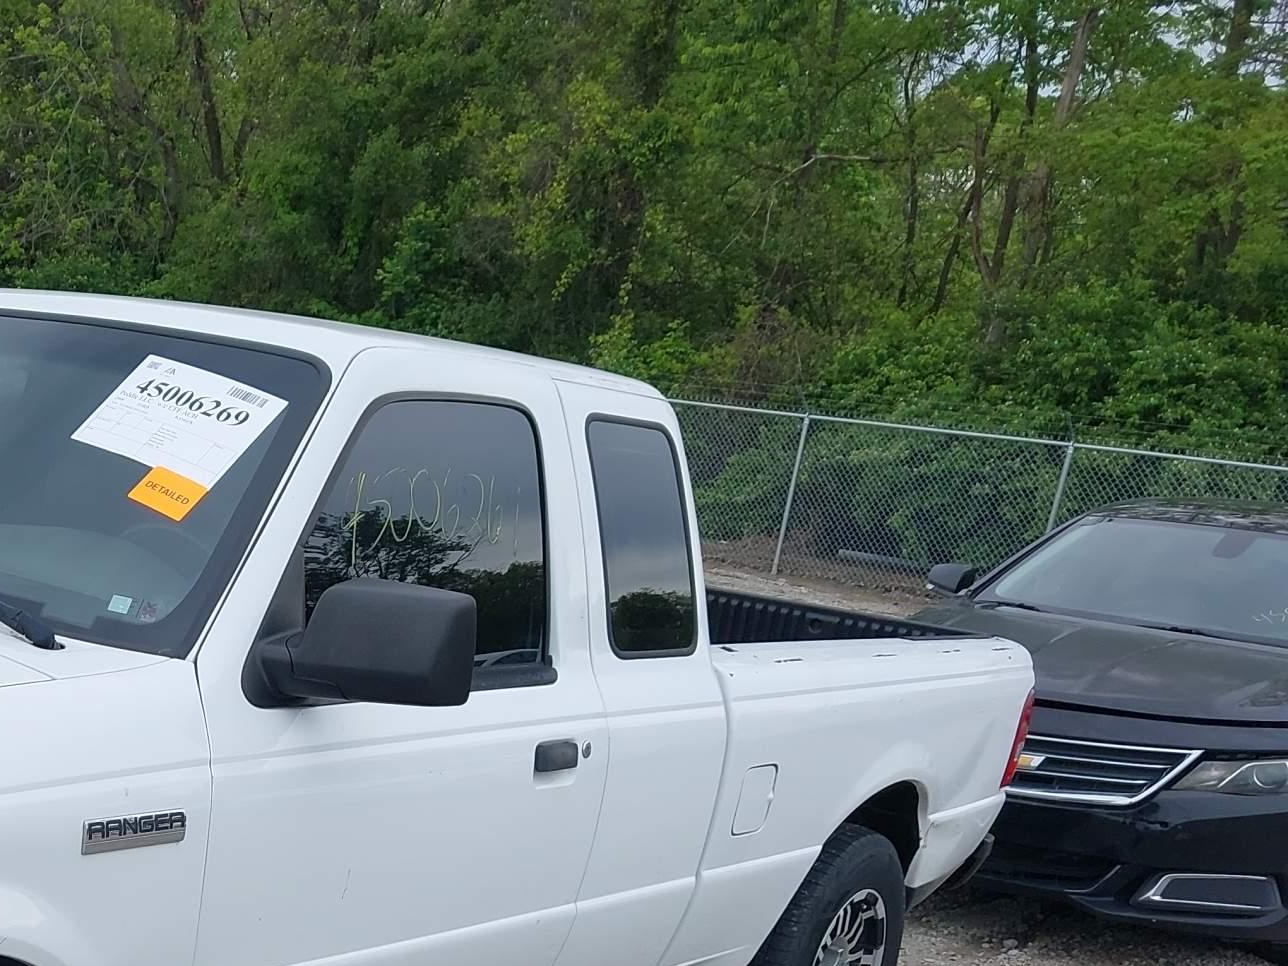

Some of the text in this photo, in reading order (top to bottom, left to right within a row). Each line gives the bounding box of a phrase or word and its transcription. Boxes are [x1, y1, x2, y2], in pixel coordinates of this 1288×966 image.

[136, 378, 250, 426] 45006269
[144, 480, 190, 505] DETAILED
[87, 811, 187, 840] RANGER
